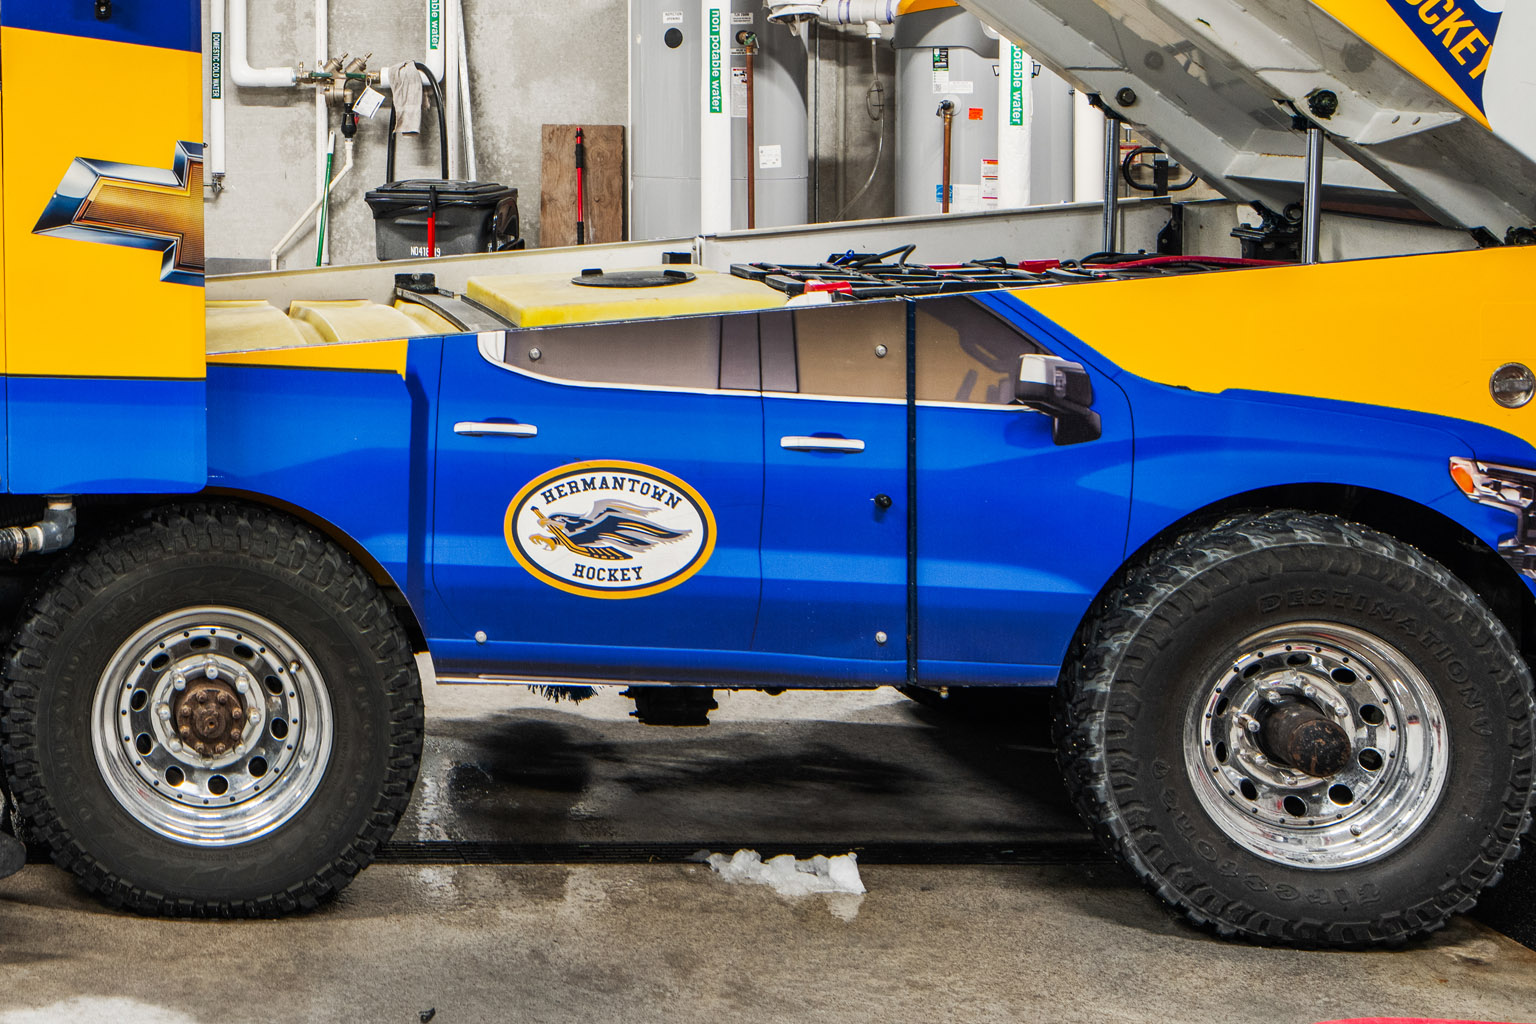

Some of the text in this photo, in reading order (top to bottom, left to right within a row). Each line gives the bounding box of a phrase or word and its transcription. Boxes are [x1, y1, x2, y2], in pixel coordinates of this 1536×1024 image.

[431, 20, 439, 48] water
[212, 33, 220, 97] DOMESTIC COLD WATER
[710, 10, 721, 112] non potable water
[1013, 90, 1022, 124] water
[540, 476, 682, 509] HERMANTOWN
[572, 563, 643, 582] HOCKEY
[1258, 588, 1482, 712] DESTINATION
